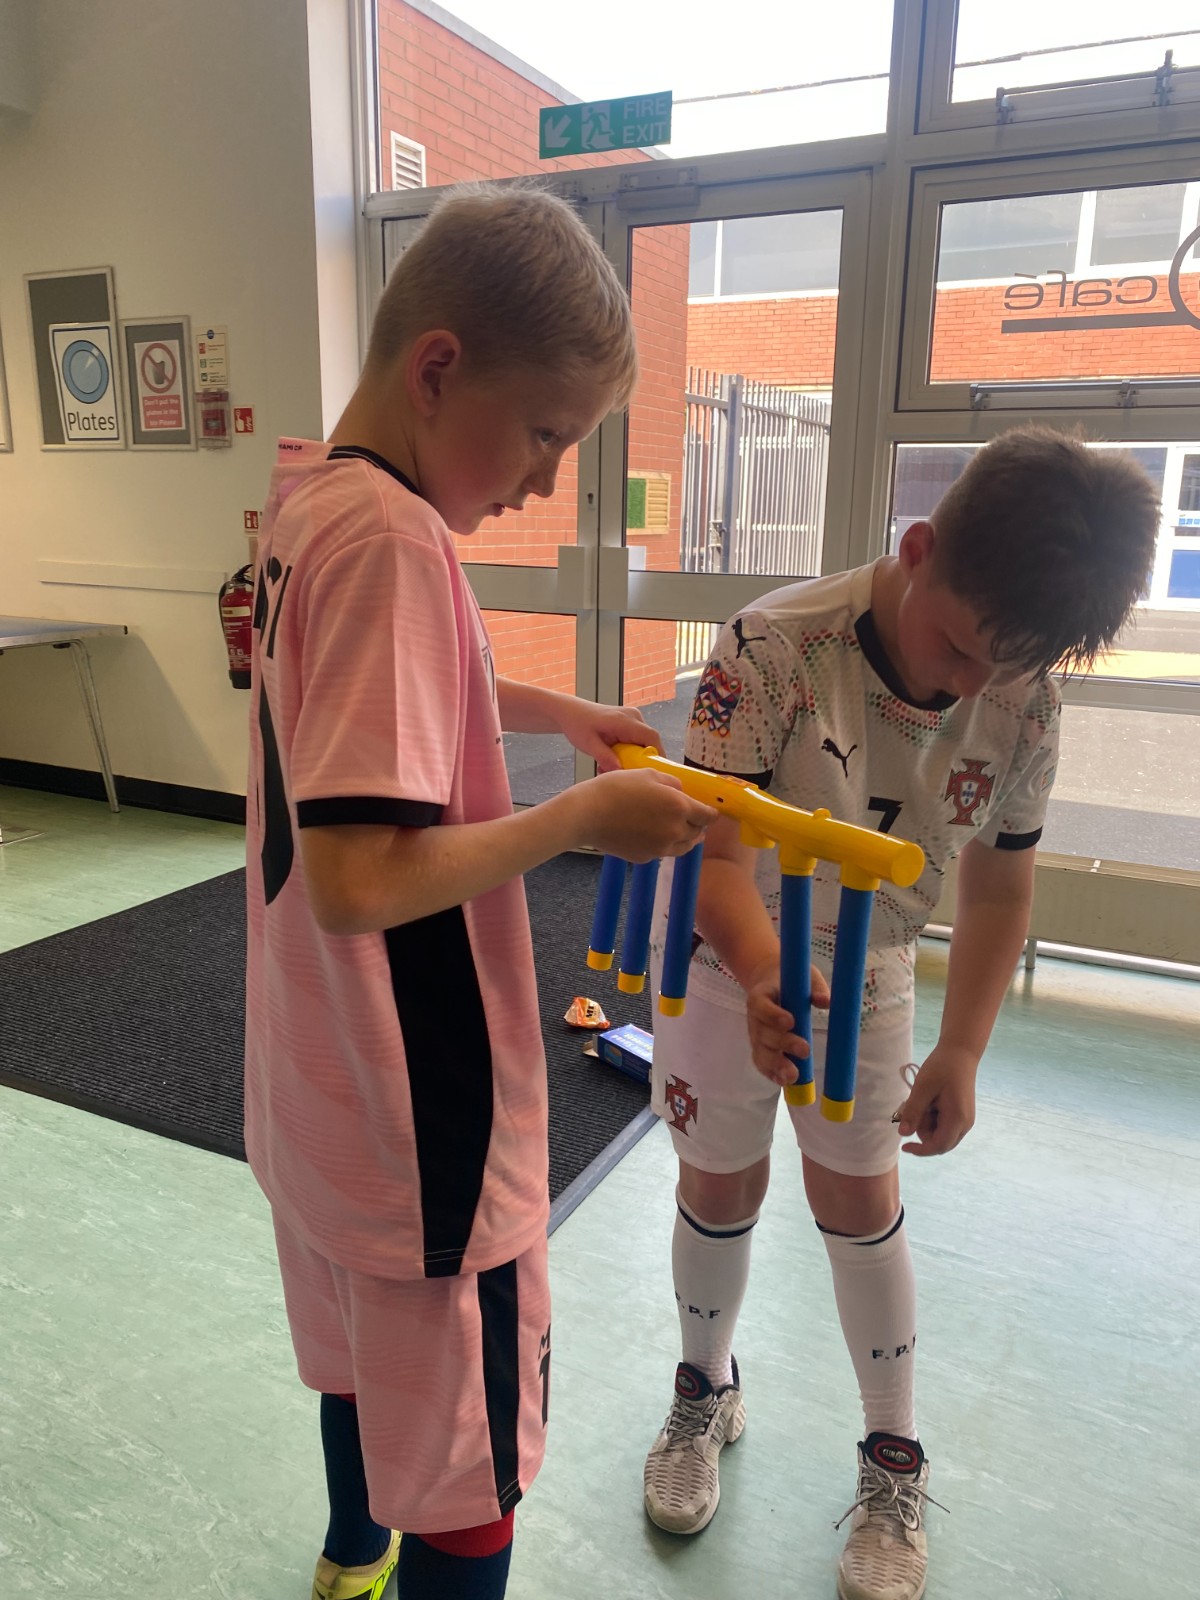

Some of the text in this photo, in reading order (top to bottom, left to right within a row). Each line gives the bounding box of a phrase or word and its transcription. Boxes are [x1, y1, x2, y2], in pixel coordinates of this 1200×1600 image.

[623, 98, 668, 120] FIRE
[622, 121, 668, 144] EXIT
[67, 412, 115, 431] Plates
[867, 796, 904, 833] 7
